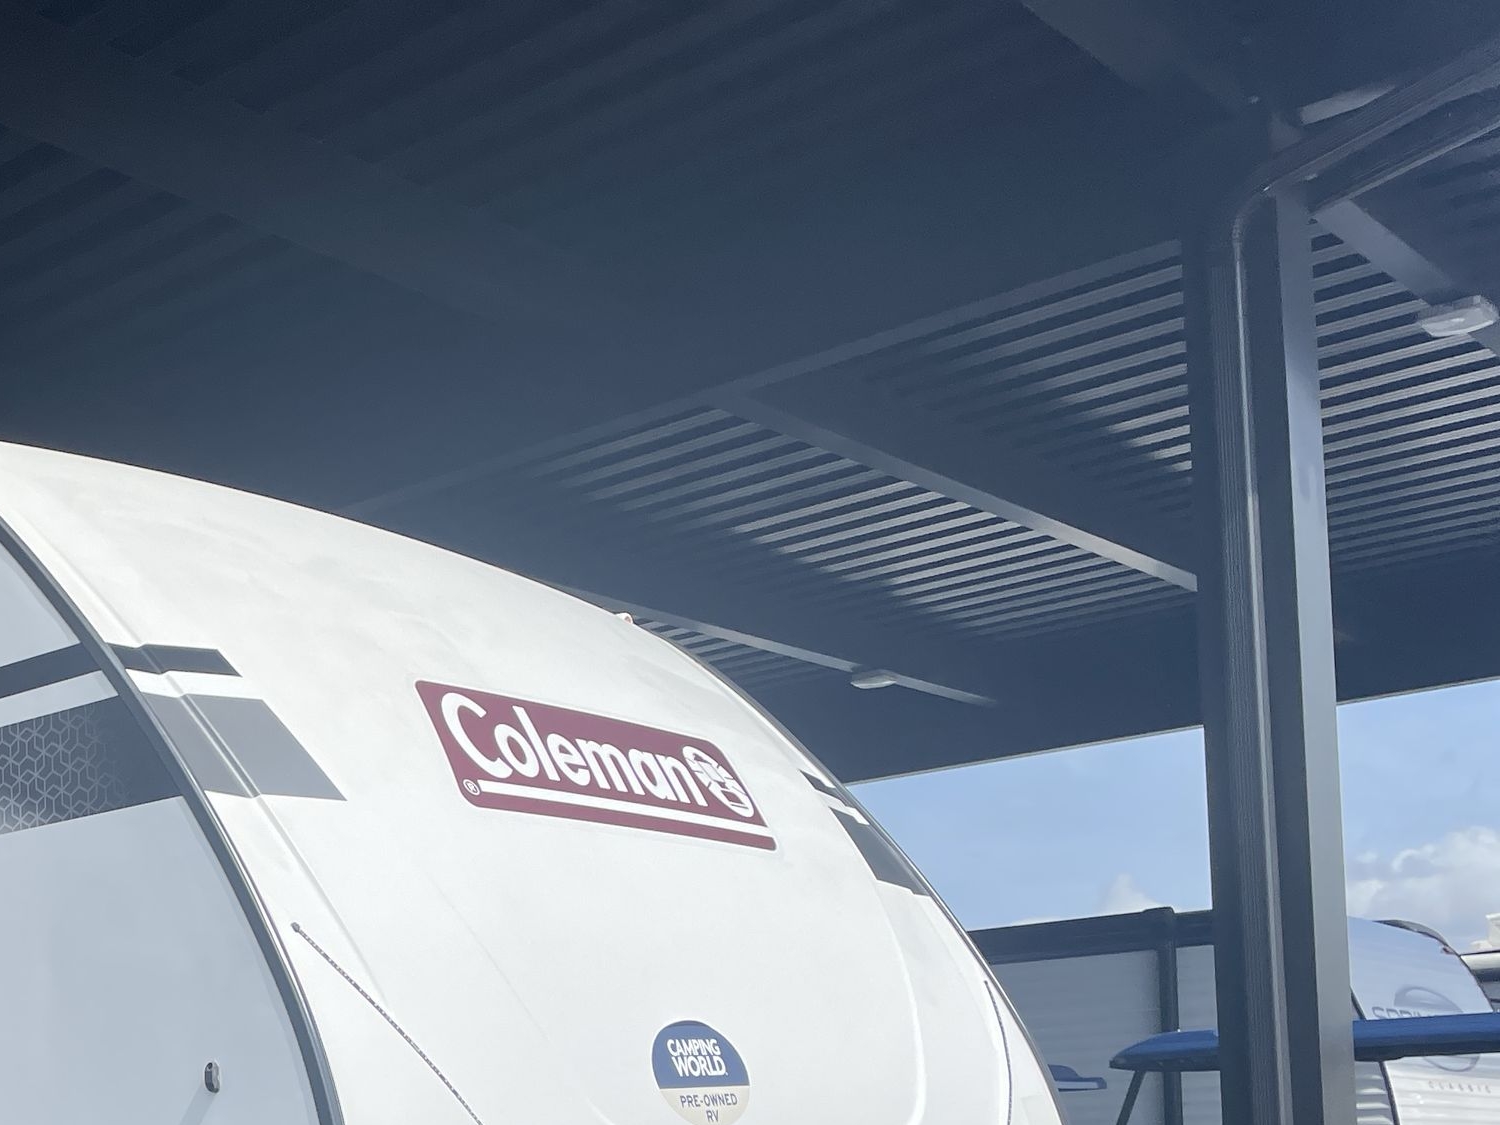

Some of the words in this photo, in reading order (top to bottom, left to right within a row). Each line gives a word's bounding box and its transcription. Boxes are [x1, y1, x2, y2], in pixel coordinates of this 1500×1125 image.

[441, 692, 708, 807] Coleman
[666, 1038, 721, 1057] CAMPING
[671, 1055, 727, 1077] WORLD
[679, 1093, 738, 1108] PRE-OWNED
[706, 1110, 719, 1122] RV
